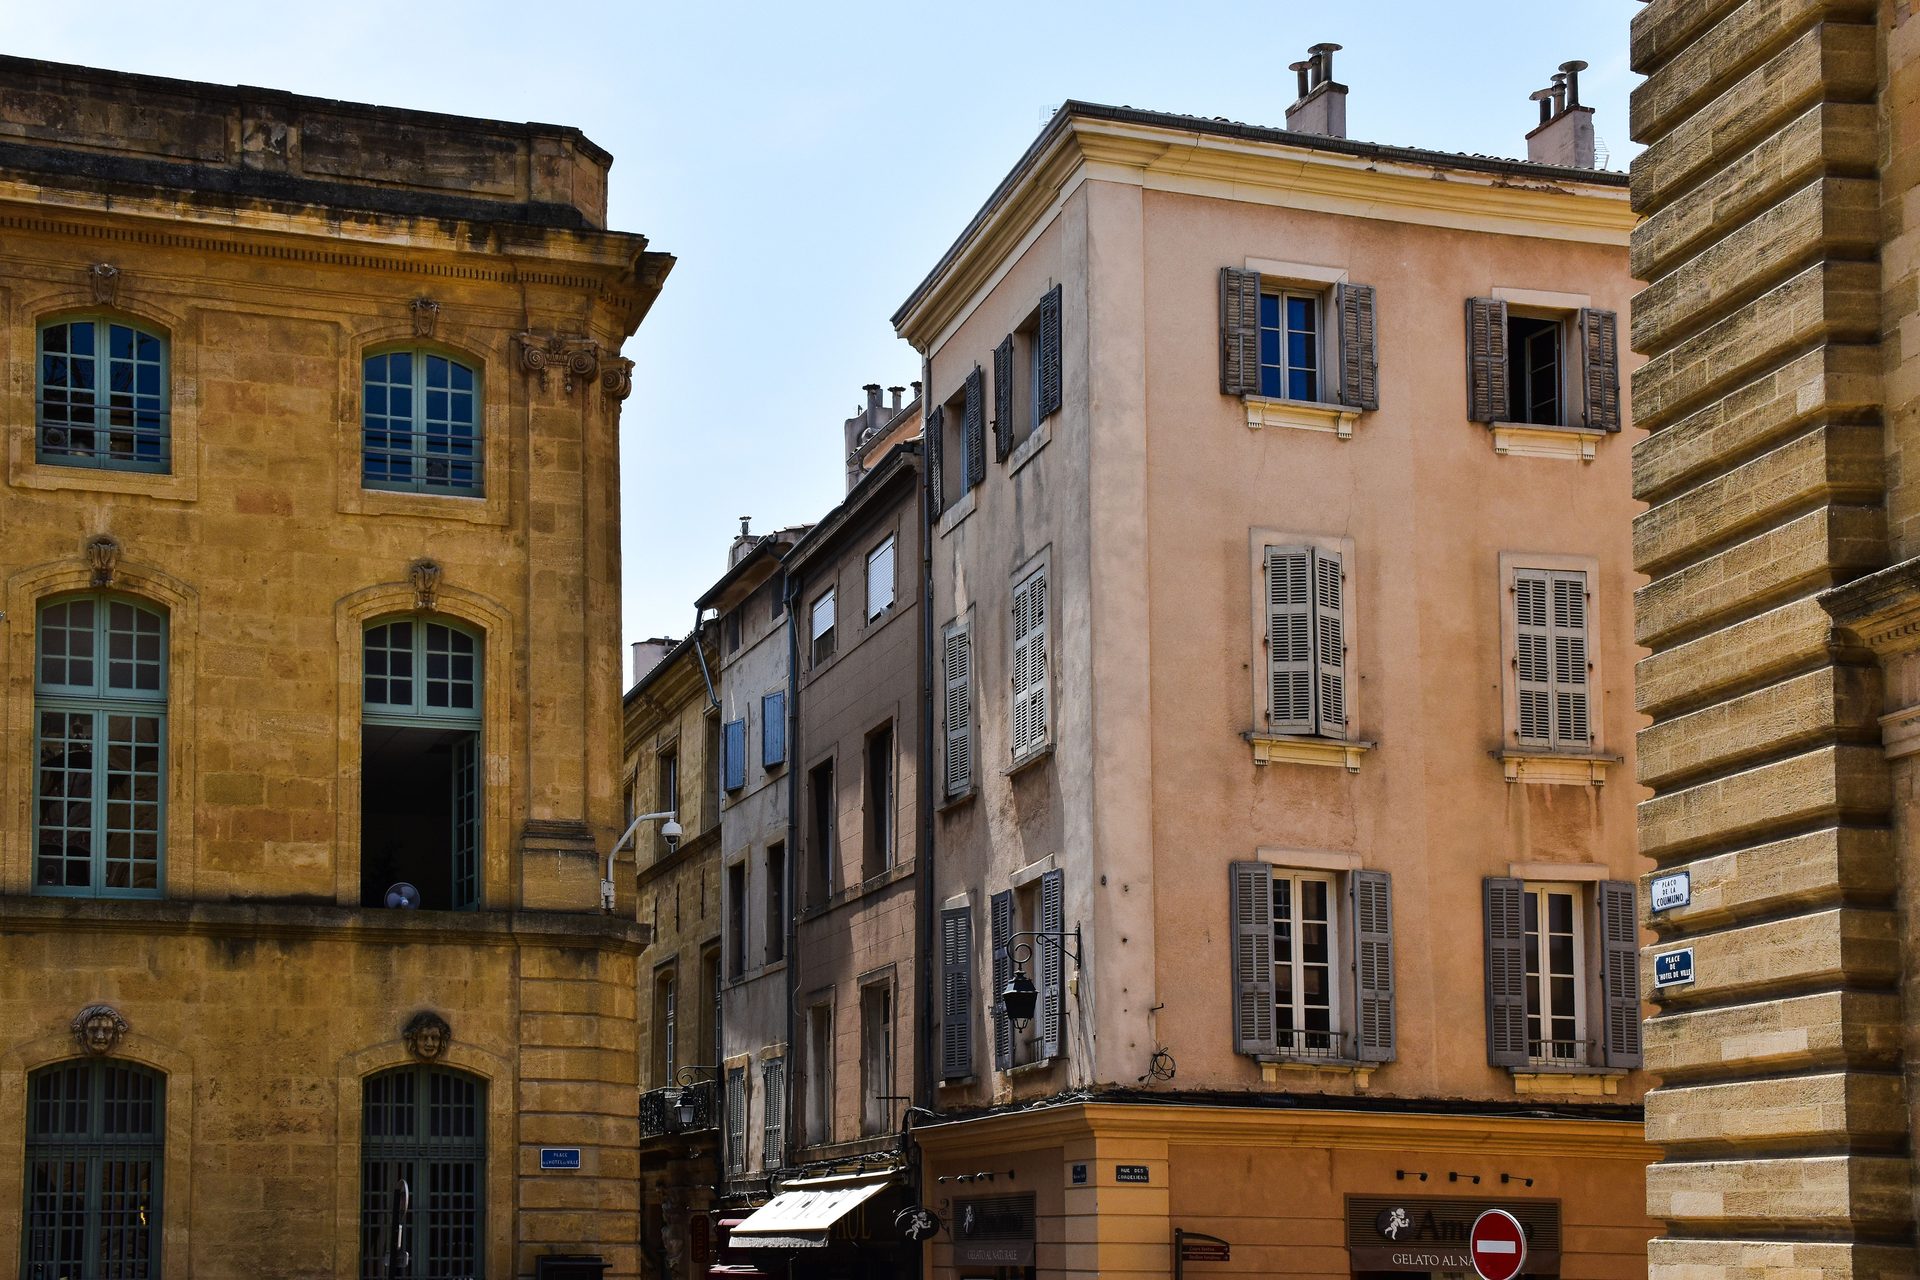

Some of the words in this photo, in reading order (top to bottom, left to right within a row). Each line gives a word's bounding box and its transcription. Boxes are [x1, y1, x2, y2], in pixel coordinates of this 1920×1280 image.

[1665, 955, 1680, 964] PLACE
[1673, 970, 1679, 978] DE
[1680, 968, 1691, 977] VILLE
[834, 1202, 872, 1240] AUL
[1392, 1253, 1439, 1266] GELATO
[1442, 1256, 1457, 1266] AL
